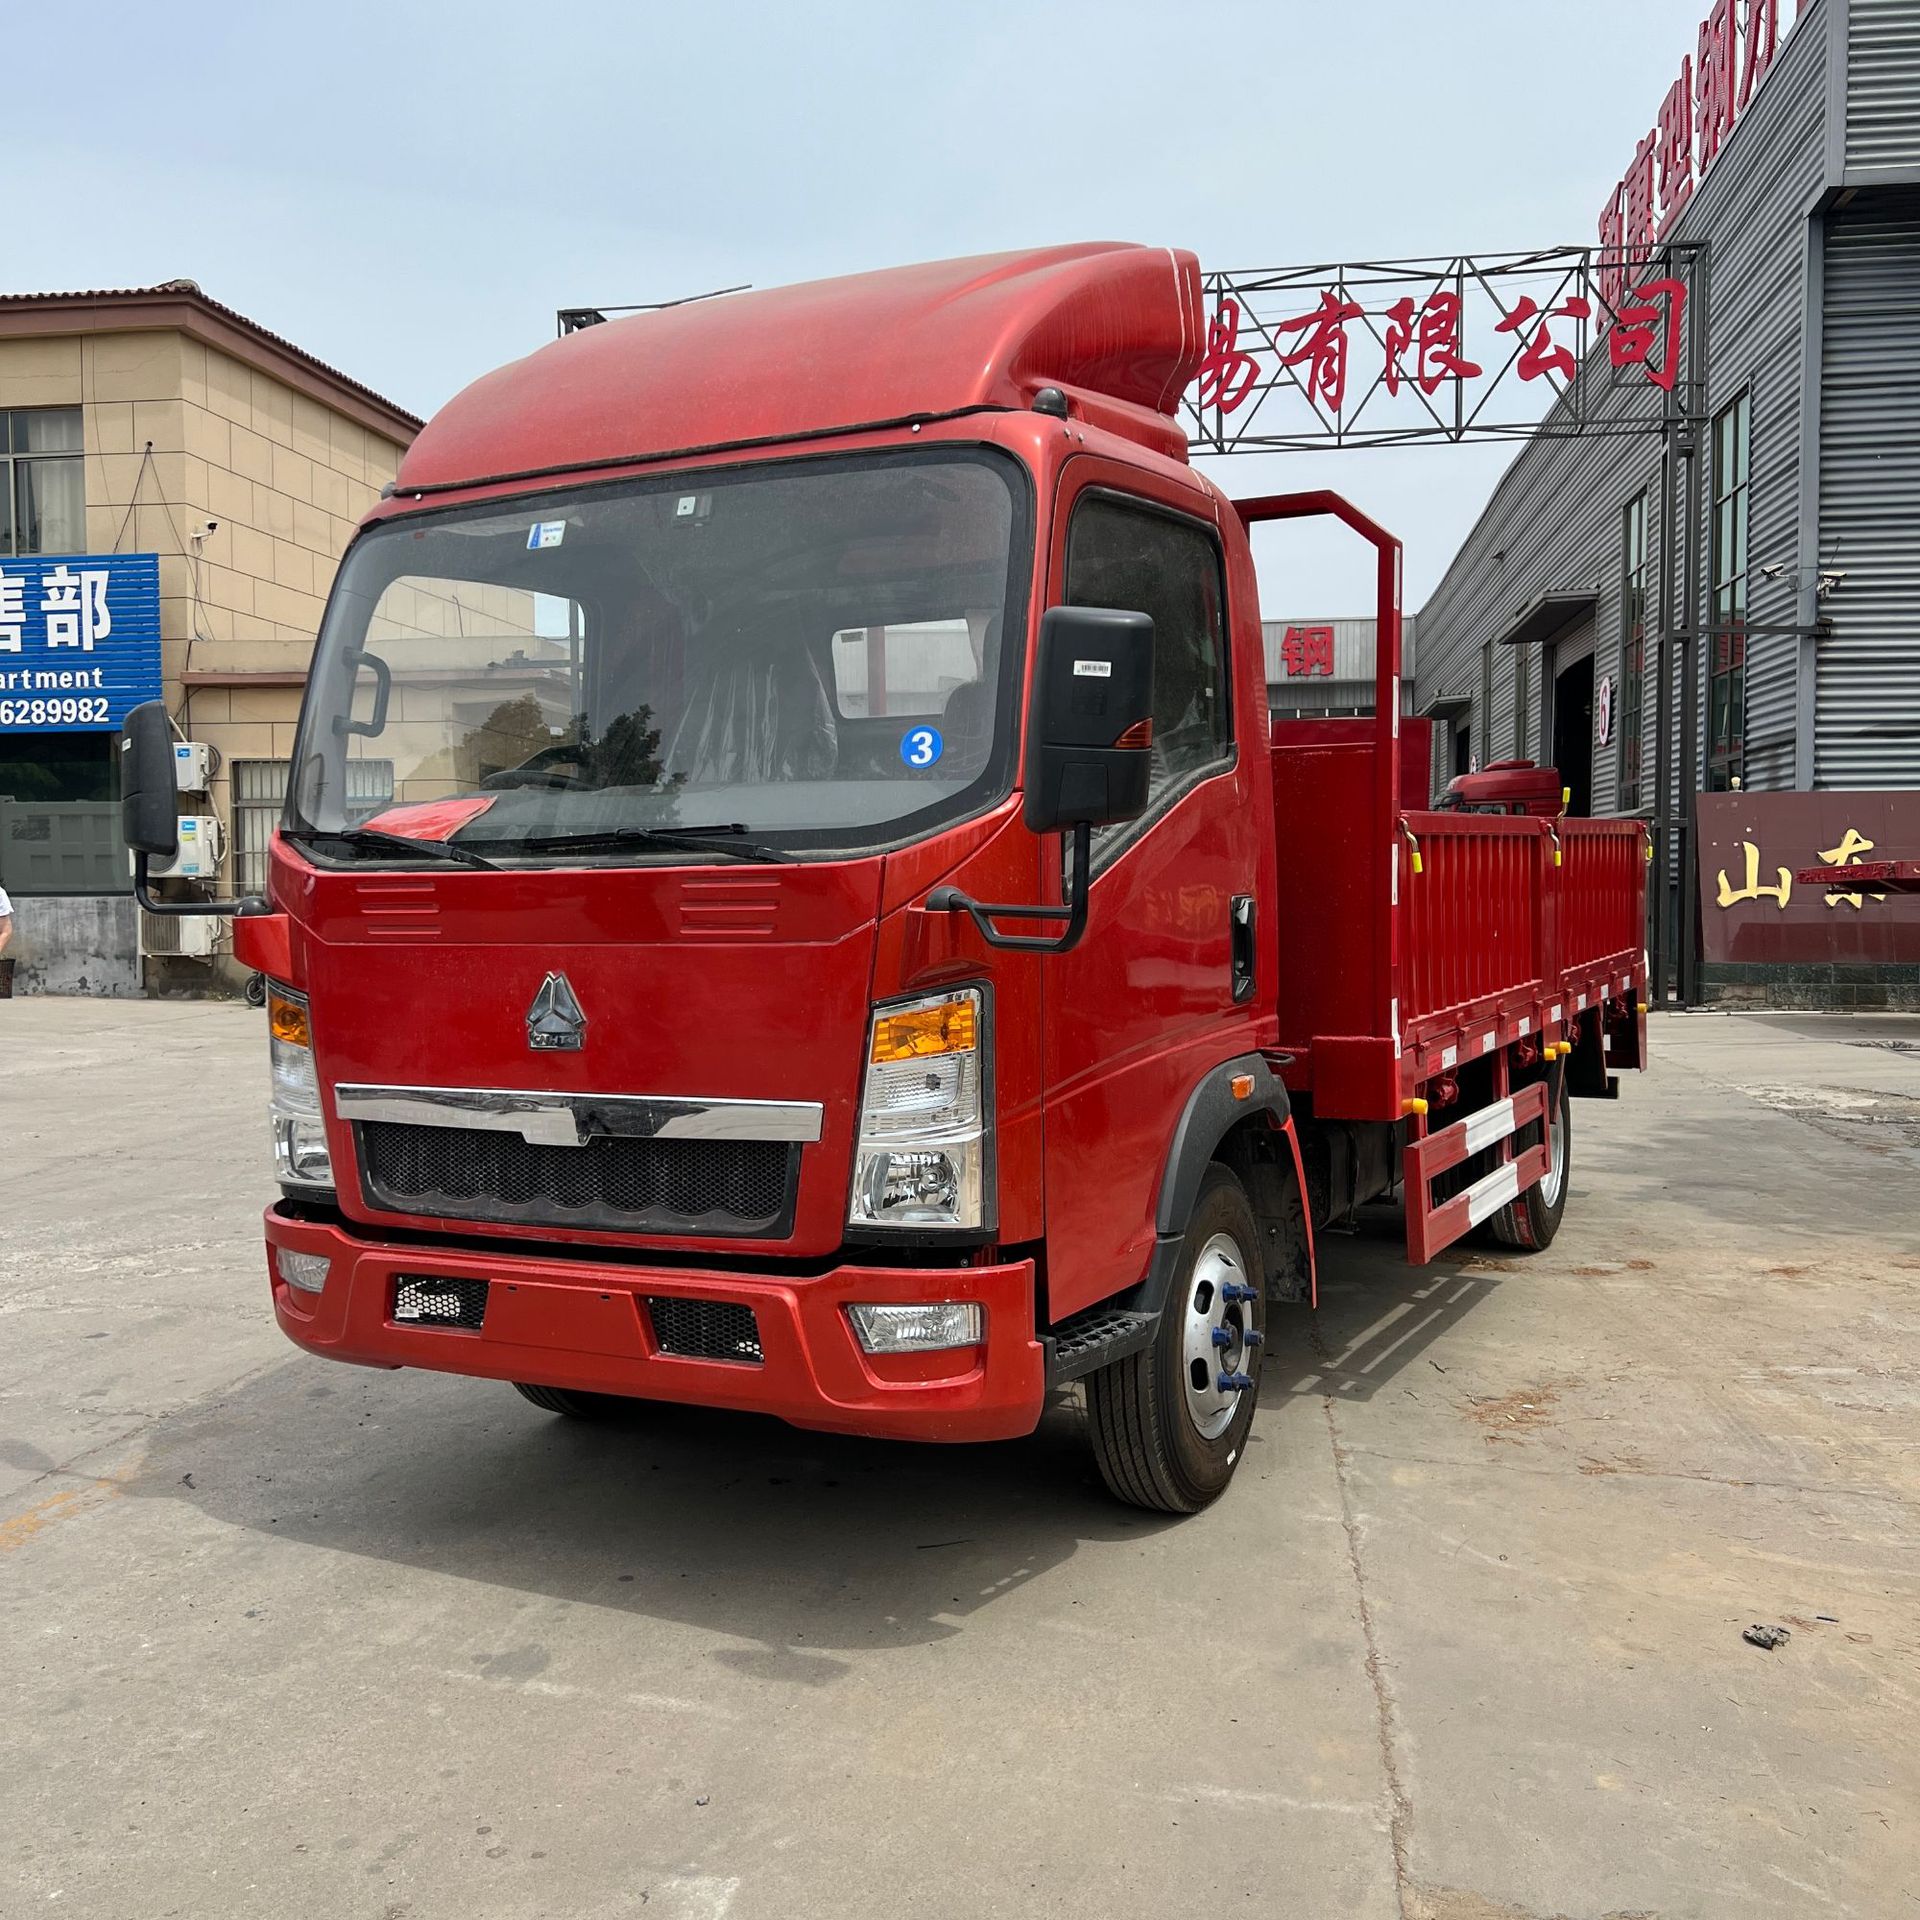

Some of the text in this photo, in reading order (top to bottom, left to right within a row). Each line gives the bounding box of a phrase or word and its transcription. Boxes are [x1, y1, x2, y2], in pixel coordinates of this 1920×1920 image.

[1195, 278, 1687, 414] 易有限公司
[1281, 626, 1334, 676] 钢
[0, 697, 110, 725] 6289982
[910, 731, 933, 765] 3
